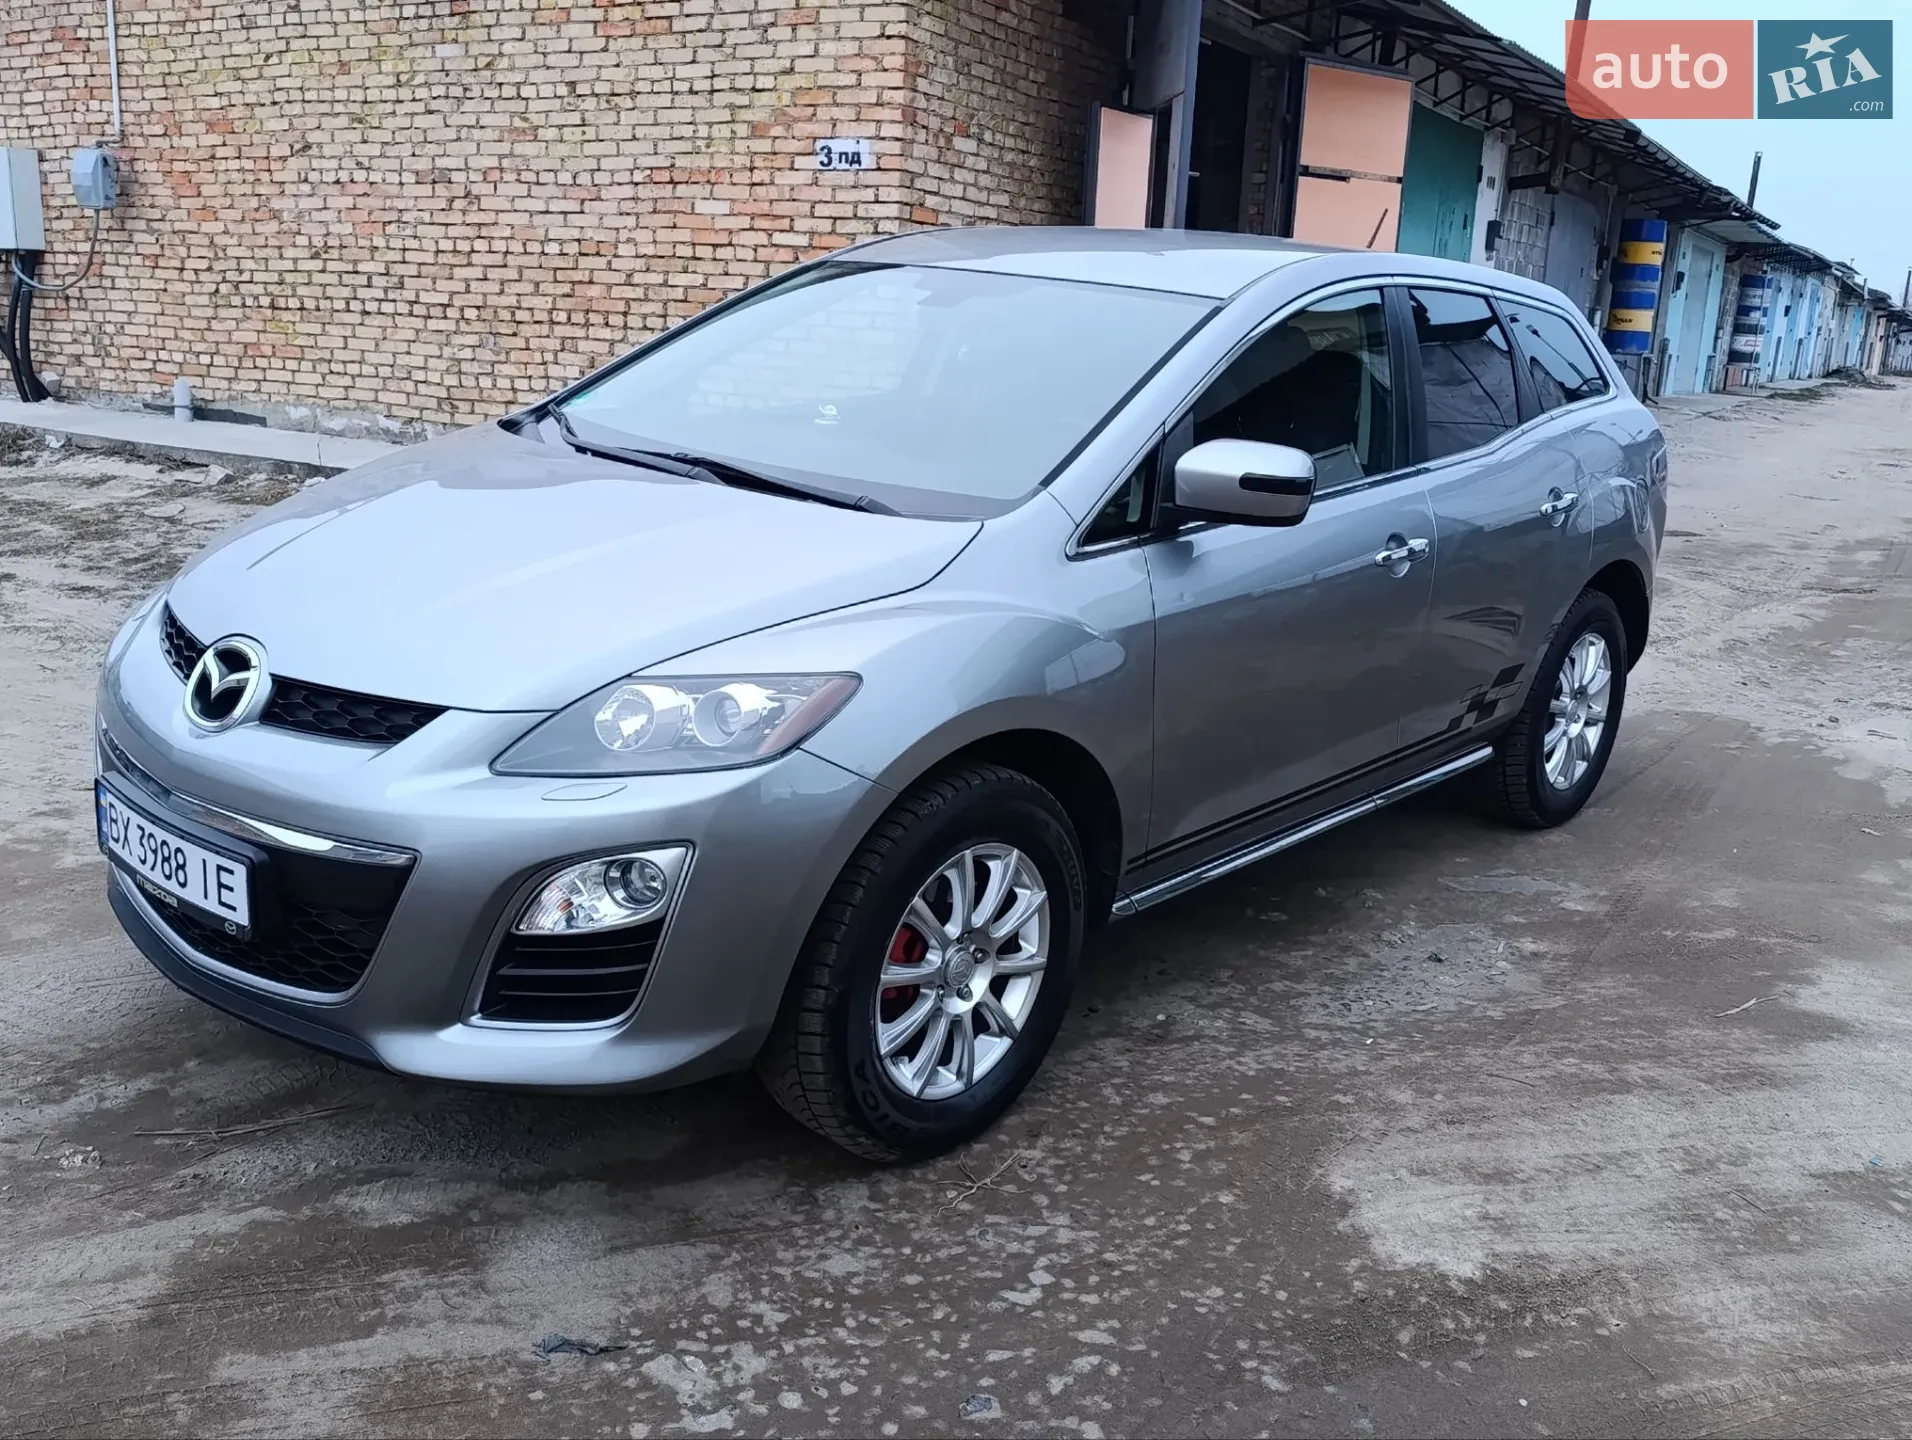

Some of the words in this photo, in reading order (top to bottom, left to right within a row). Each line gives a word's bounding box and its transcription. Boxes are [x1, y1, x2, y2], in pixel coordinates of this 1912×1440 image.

[819, 145, 833, 167] 3
[108, 802, 132, 856] BX
[136, 823, 188, 889] 3988
[202, 858, 237, 912] IE
